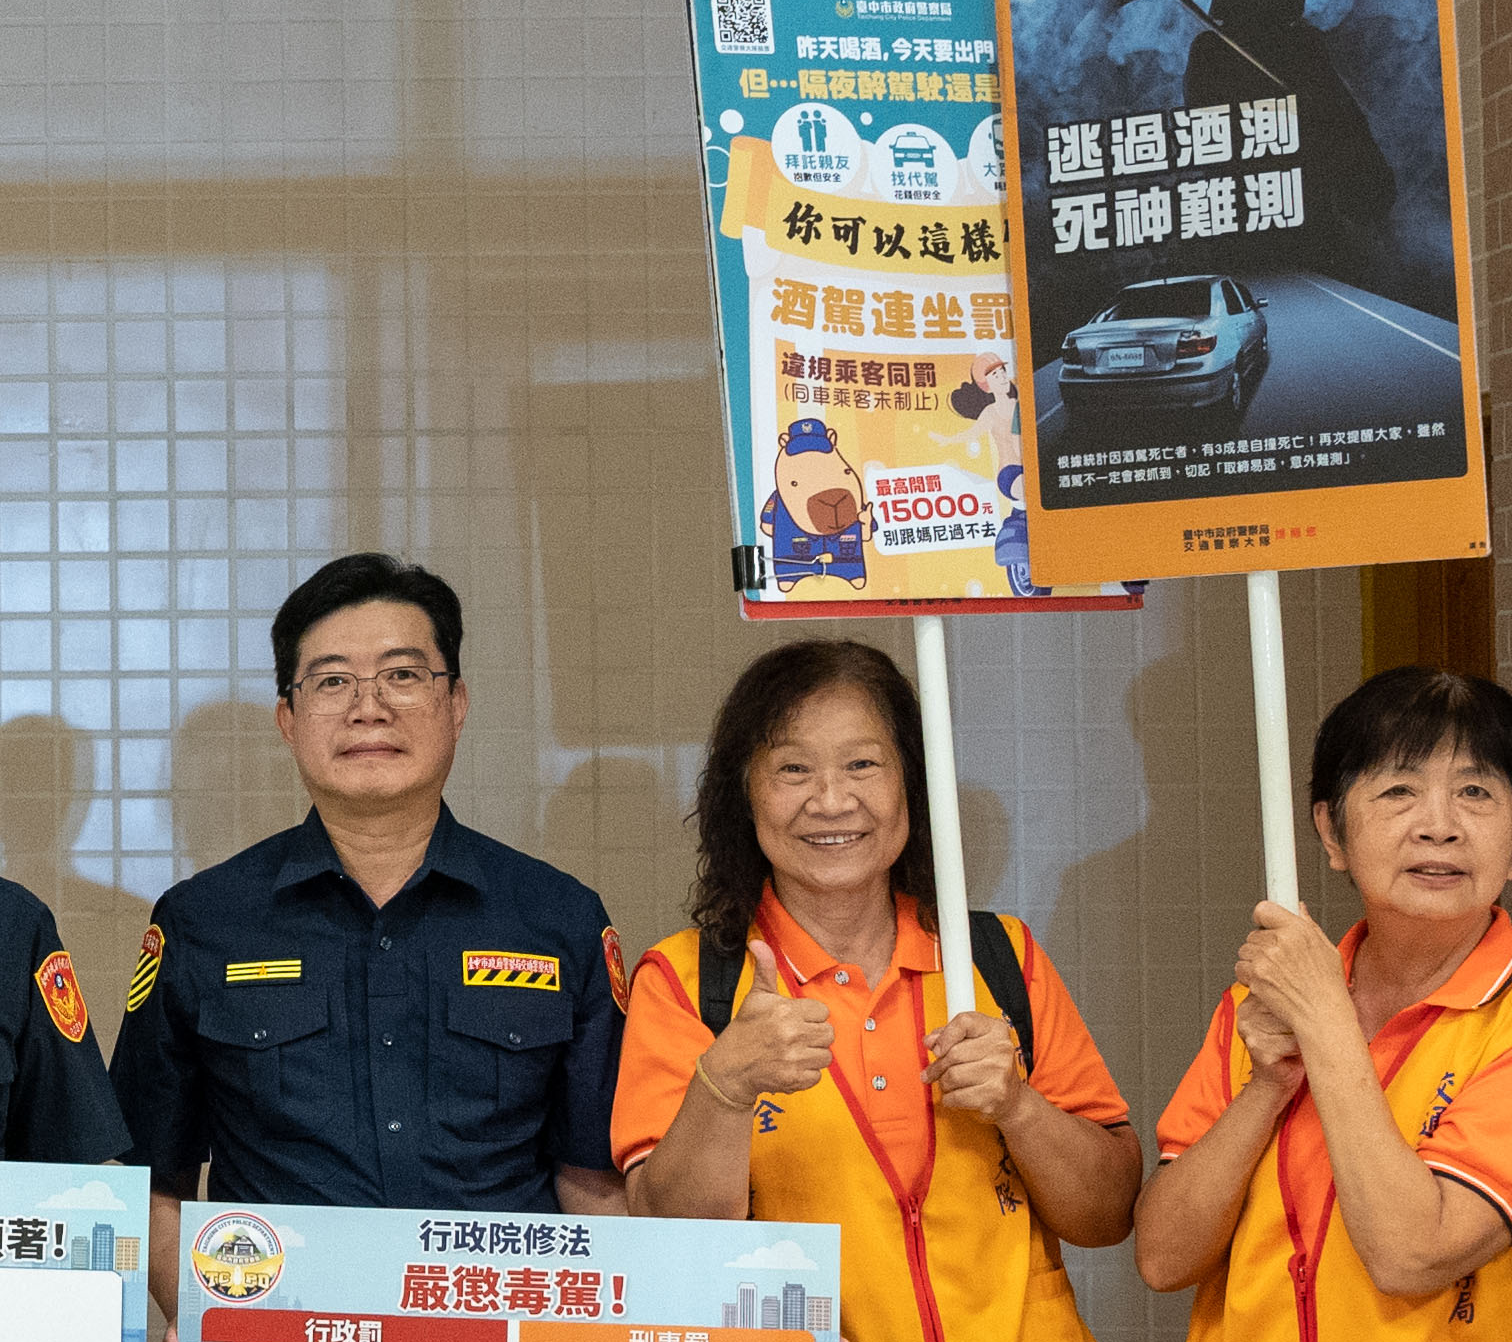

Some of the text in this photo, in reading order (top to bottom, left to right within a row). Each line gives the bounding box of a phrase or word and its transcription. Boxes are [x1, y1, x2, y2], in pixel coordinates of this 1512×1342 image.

[1048, 95, 1300, 183] 逃過酒測
[785, 154, 850, 170] 拜託親友
[891, 171, 938, 187] 找代駕
[895, 190, 940, 200] 花錢但安全
[1052, 168, 1304, 254] 死神難測
[783, 201, 1009, 263] 你可以這樣
[771, 278, 1014, 340] 酒駕連坐罰
[781, 352, 936, 388] 違規乘客同罰
[784, 383, 939, 411] (同車乘客未制止)
[876, 475, 942, 495] 最高開罰
[884, 521, 996, 546] 別跟媽尼過不去
[419, 1220, 593, 1257] 行政院修法
[401, 1263, 627, 1318] 嚴懲毒駕!
